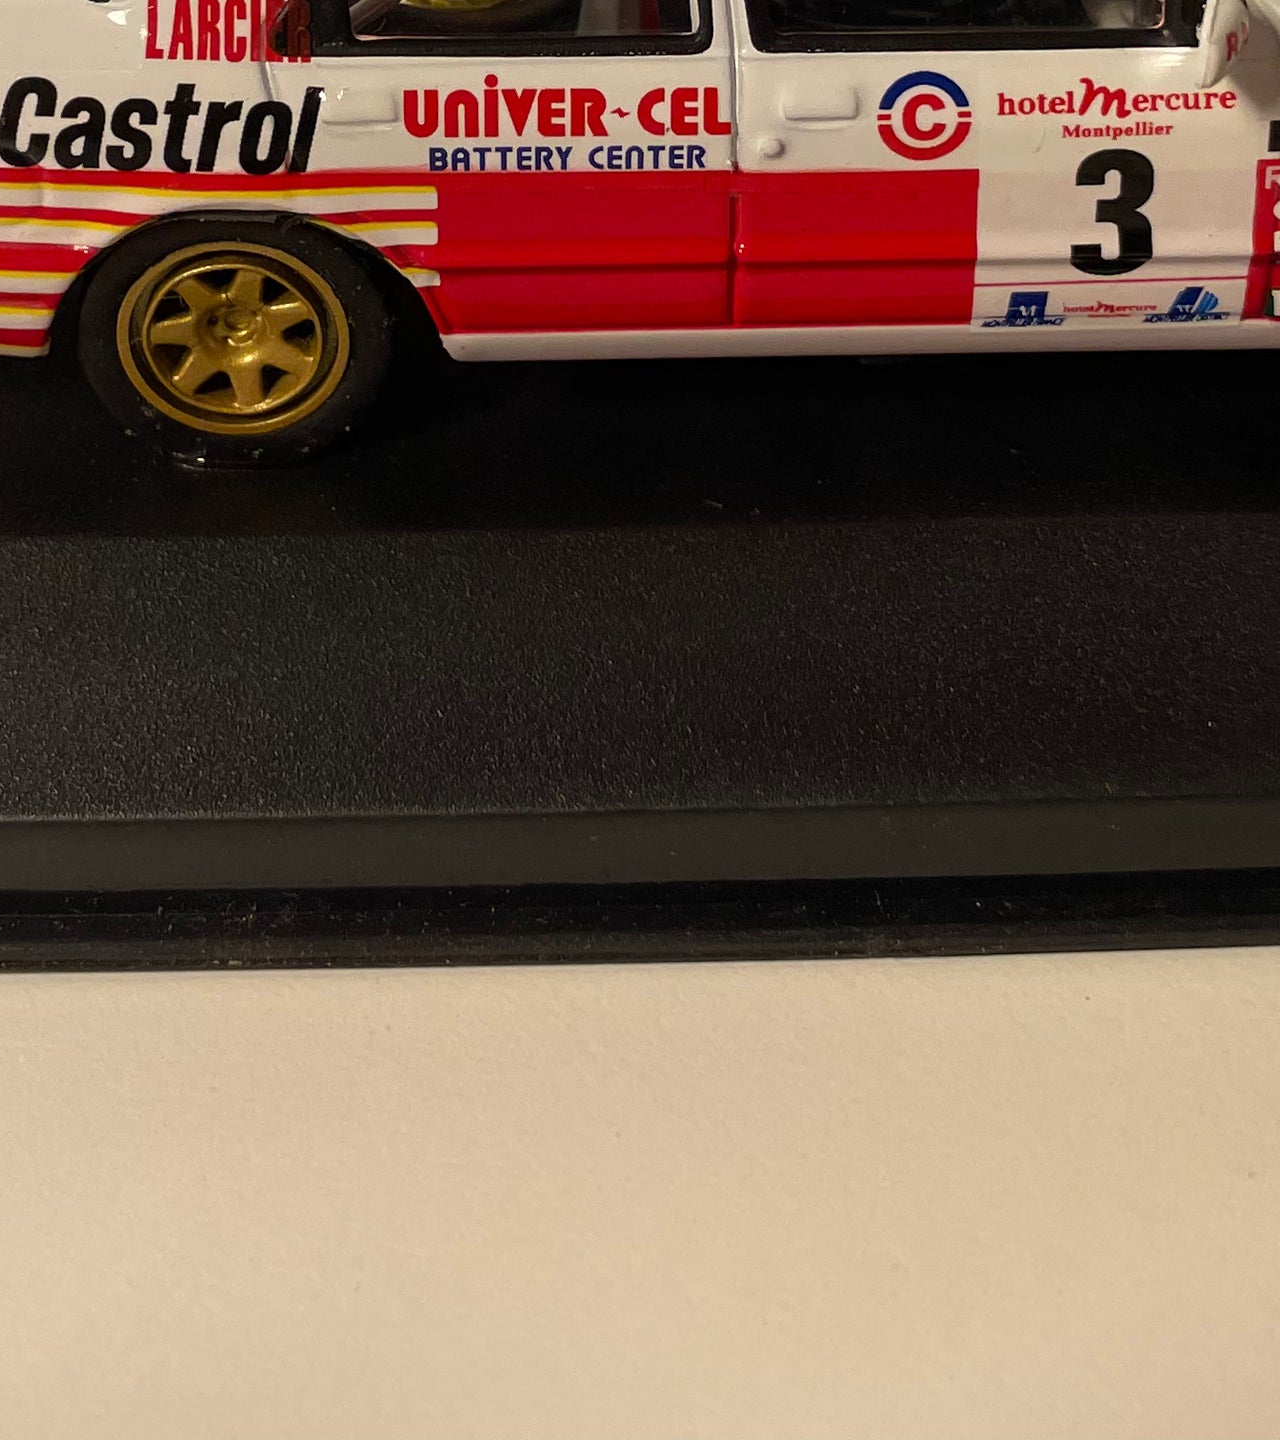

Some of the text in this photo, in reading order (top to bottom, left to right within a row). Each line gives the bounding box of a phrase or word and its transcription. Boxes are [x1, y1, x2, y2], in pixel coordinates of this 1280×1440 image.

[997, 91, 1075, 116] hotel
[1061, 122, 1173, 140] Montpellier
[429, 145, 706, 172] BATTERY CENTER
[1070, 148, 1155, 276] 3
